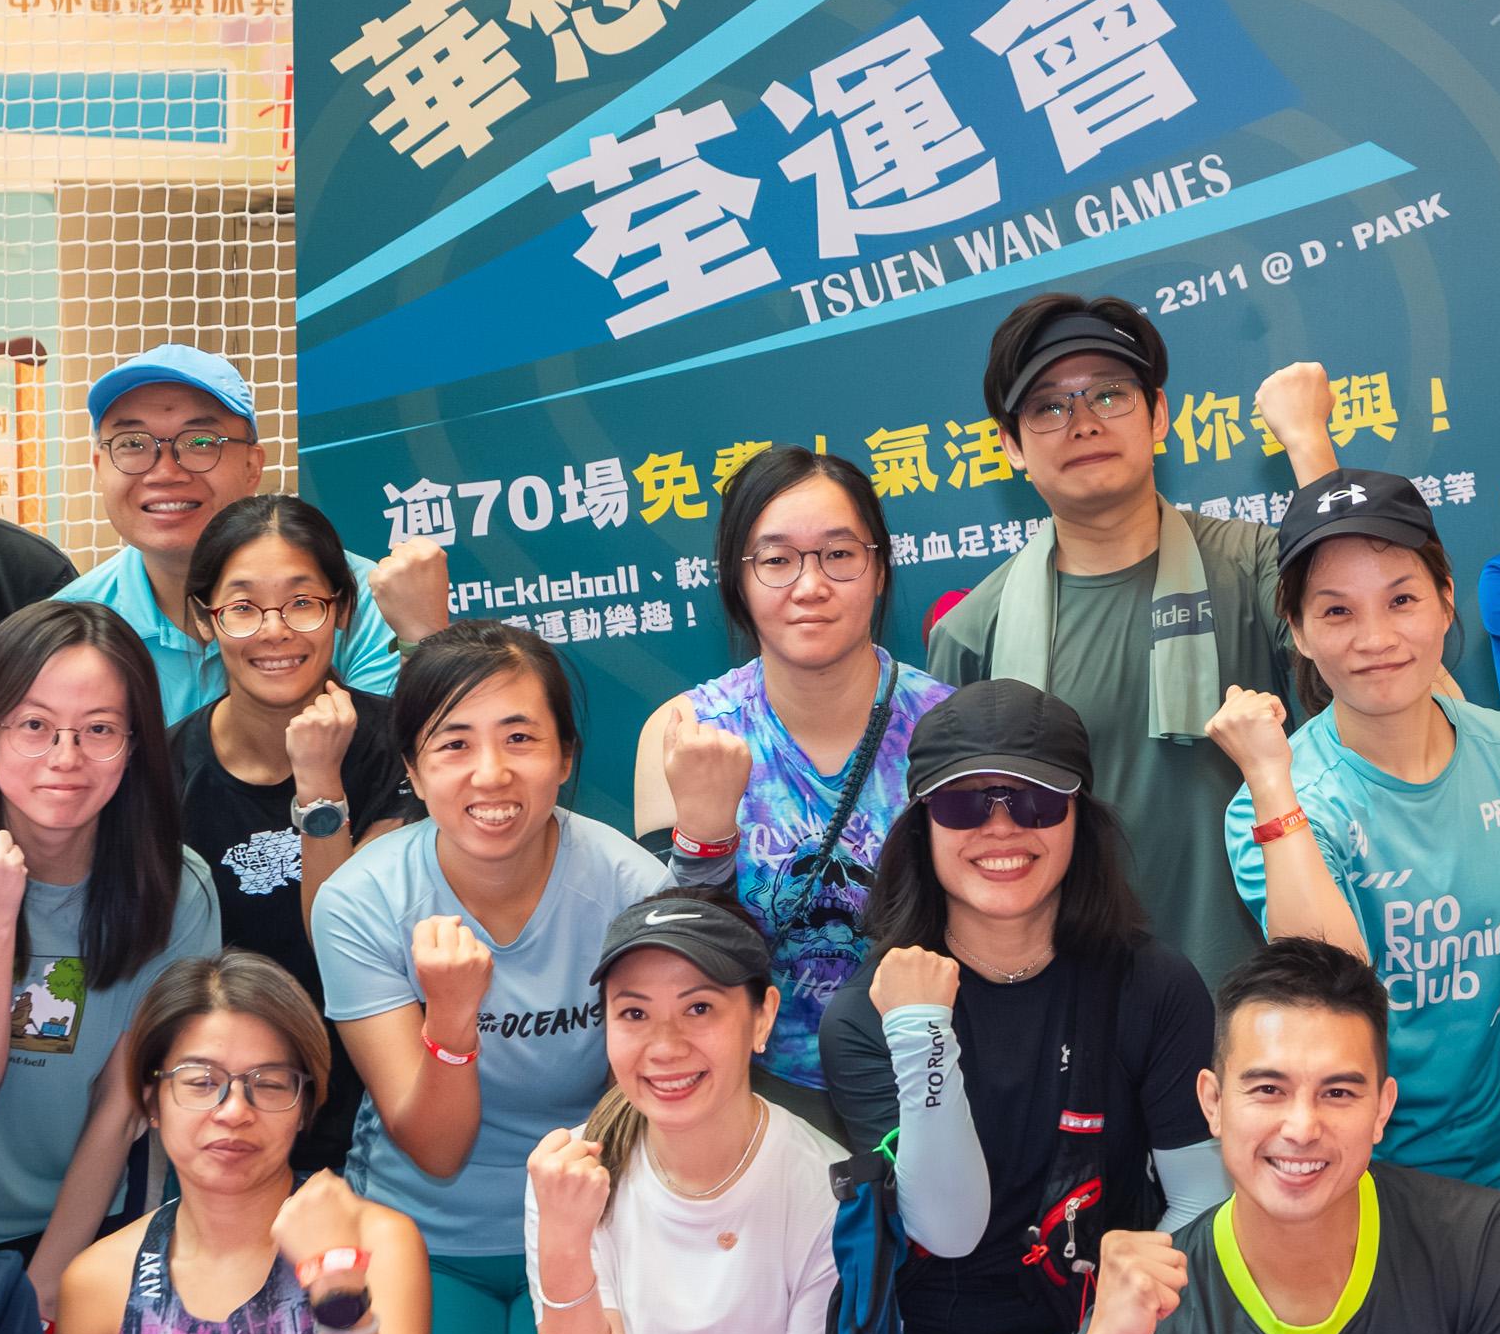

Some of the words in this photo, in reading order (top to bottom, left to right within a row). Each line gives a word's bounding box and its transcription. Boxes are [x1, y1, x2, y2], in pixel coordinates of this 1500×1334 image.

[791, 241, 947, 327] TSUEN
[953, 206, 1059, 287] WAN
[1077, 153, 1233, 243] GAMES
[1154, 264, 1249, 315] 23/11
[1260, 251, 1293, 286] @
[1351, 192, 1451, 251] PARK
[1383, 895, 1461, 938] Pro
[1385, 967, 1481, 1011] Club
[500, 999, 606, 1039] OCEANS
[925, 1069, 945, 1109] Pro
